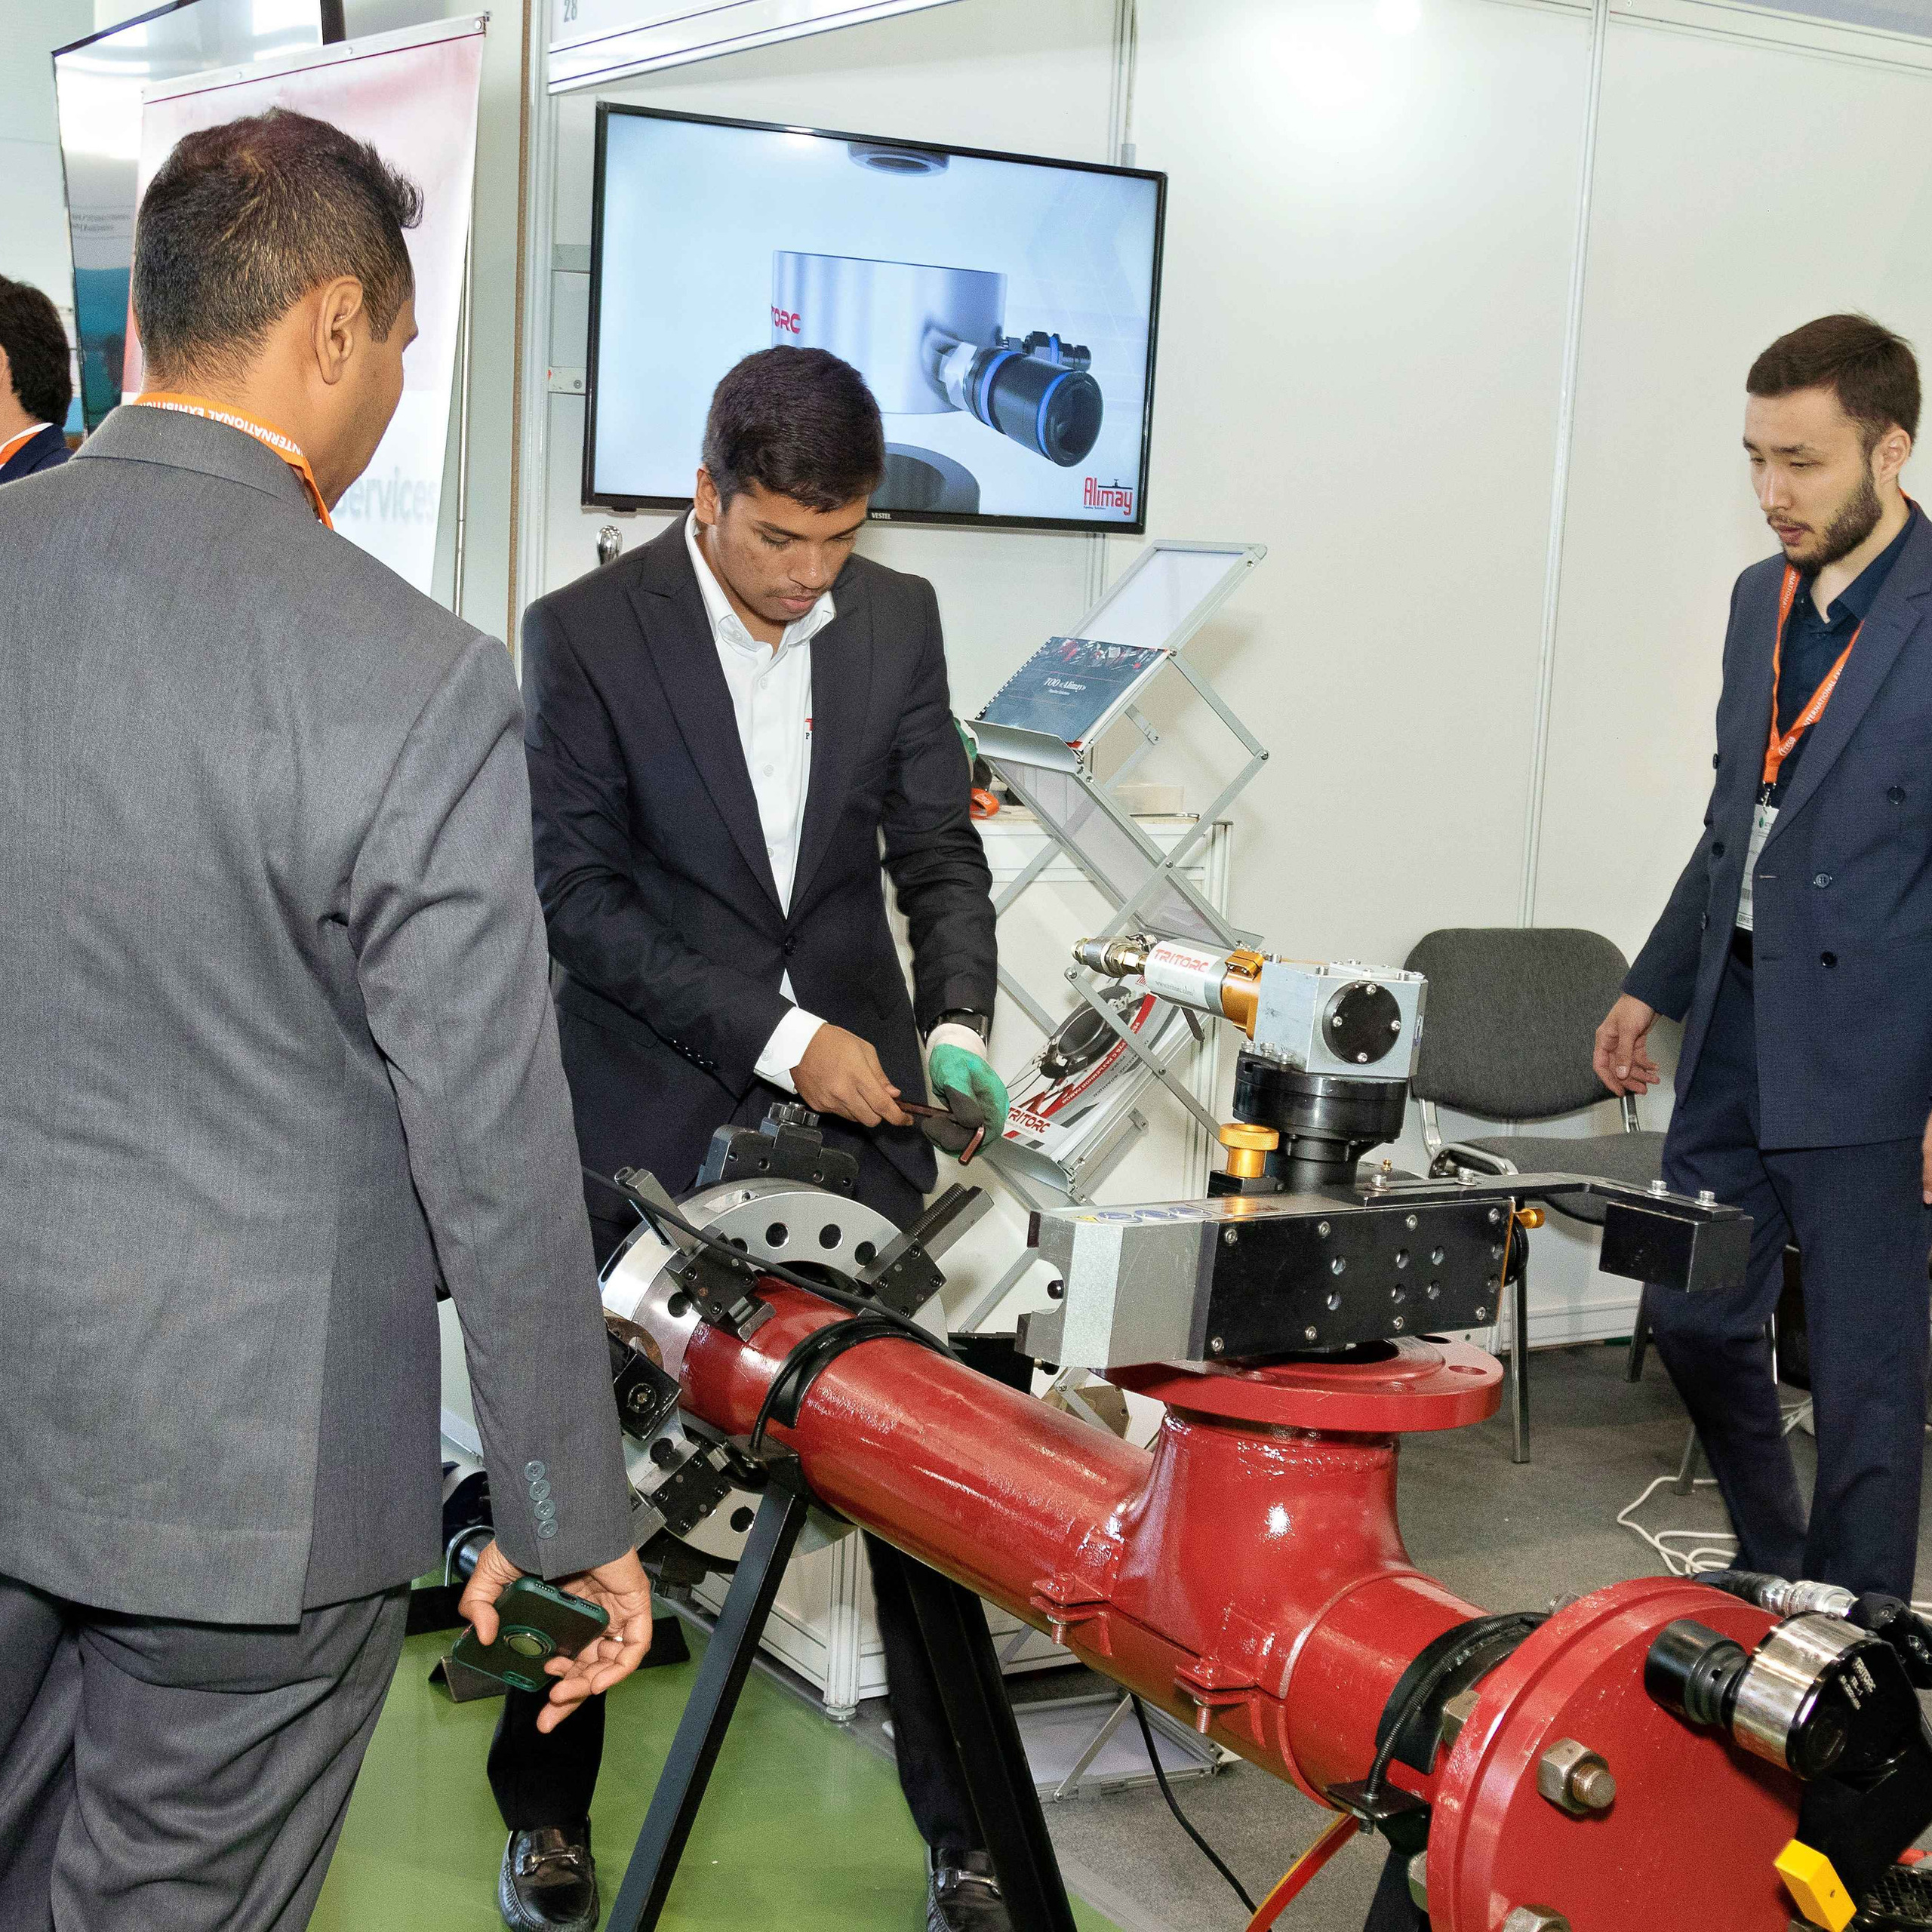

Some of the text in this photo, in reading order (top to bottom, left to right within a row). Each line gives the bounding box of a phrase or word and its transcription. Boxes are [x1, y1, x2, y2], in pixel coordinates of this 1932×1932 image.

[1084, 477, 1133, 515] Alimay
[1804, 676, 1833, 727] NTERNATIONAL
[1154, 949, 1209, 972] TRITORC
[1008, 1107, 1051, 1134] TRITORC
